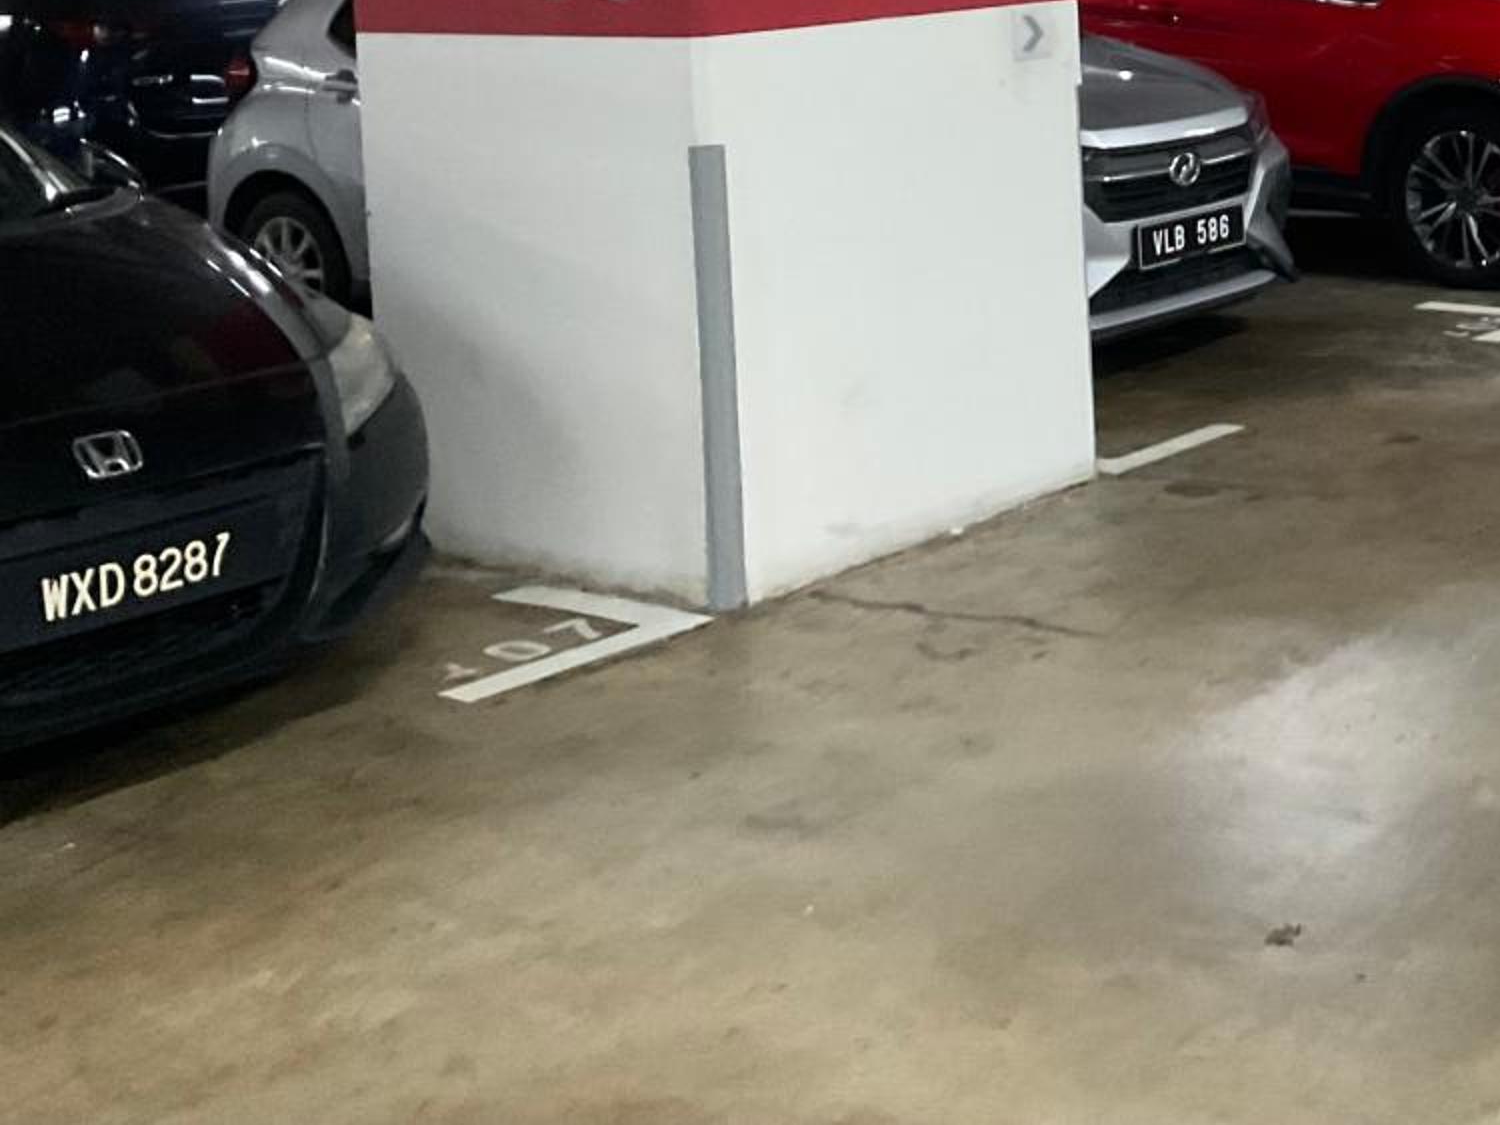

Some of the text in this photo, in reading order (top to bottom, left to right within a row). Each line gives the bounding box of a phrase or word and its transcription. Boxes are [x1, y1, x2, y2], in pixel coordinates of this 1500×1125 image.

[1153, 214, 1230, 256] VLB 586
[41, 531, 230, 621] WXD 8287
